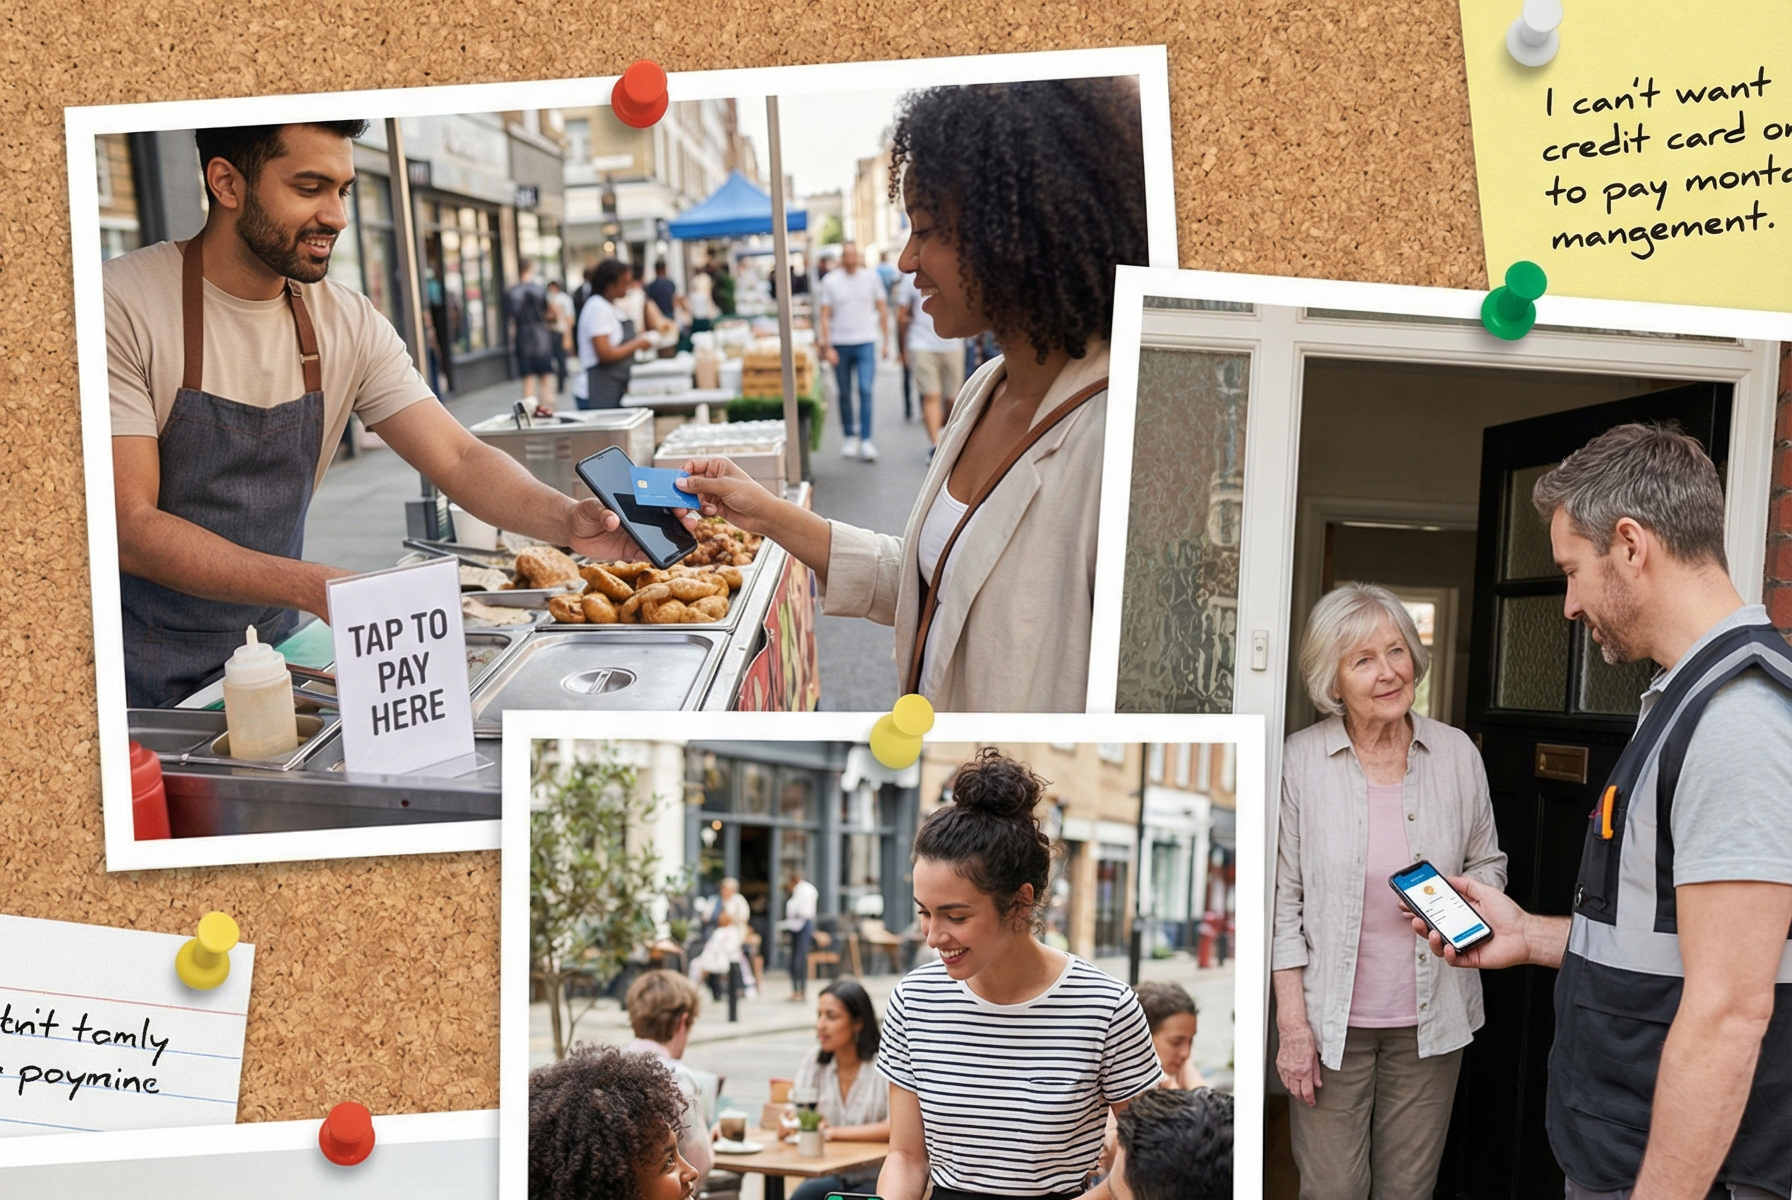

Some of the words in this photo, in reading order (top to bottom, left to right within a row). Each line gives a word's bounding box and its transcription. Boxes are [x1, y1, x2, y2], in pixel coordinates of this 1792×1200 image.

[1546, 87, 1553, 117] I
[1572, 76, 1661, 115] can't
[1676, 66, 1772, 105] want
[1542, 122, 1651, 162] credit
[1667, 110, 1746, 151] card
[1545, 175, 1587, 206] to
[1602, 180, 1668, 215] pay
[1552, 200, 1775, 260] mangement.
[347, 618, 404, 658] TAP
[410, 608, 448, 644] TO
[378, 651, 430, 694] PAY
[371, 688, 446, 736] HERE
